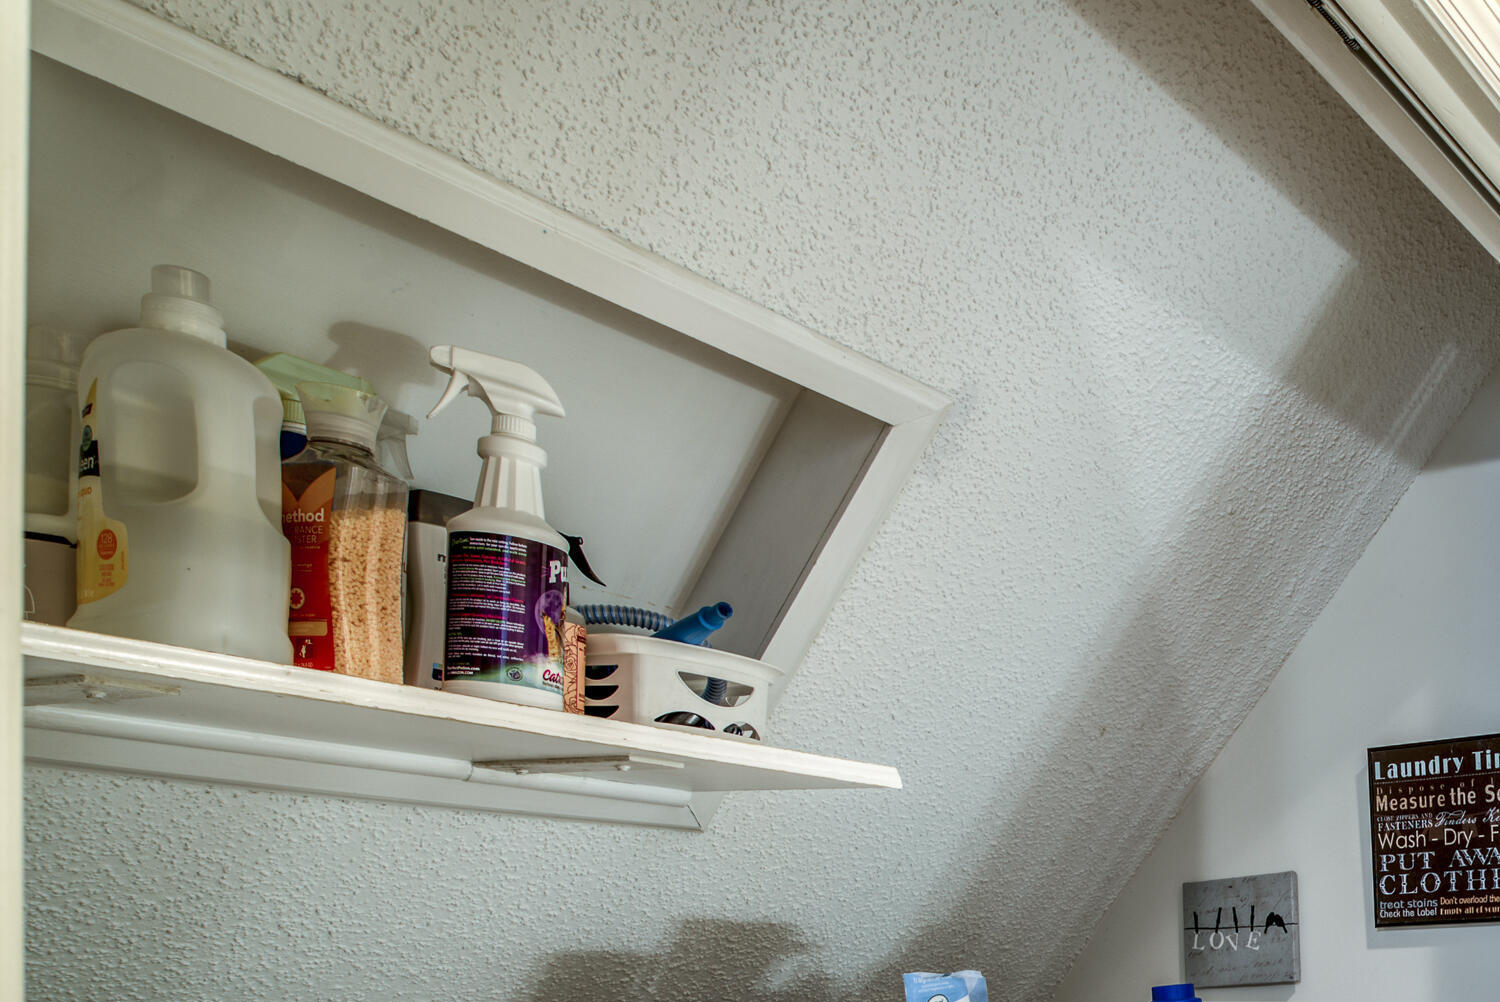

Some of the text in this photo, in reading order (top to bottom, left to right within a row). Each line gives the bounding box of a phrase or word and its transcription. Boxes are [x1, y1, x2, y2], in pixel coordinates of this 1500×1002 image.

[1375, 755, 1464, 780] Laundry
[1376, 783, 1445, 795] Dispose
[1376, 794, 1446, 812] Measure
[1449, 787, 1477, 806] the
[1378, 820, 1433, 832] FASTENERS
[1434, 810, 1478, 828] Finders
[1378, 829, 1427, 850] Wash
[1444, 828, 1474, 848] Dry
[1378, 851, 1436, 873] PUT
[1380, 898, 1439, 910] treat stains
[1440, 896, 1458, 905] Don't
[1459, 894, 1488, 904] overload
[1489, 894, 1500, 903] the
[1380, 909, 1401, 918] Check
[1403, 908, 1415, 917] the
[1191, 930, 1262, 951] LOVE
